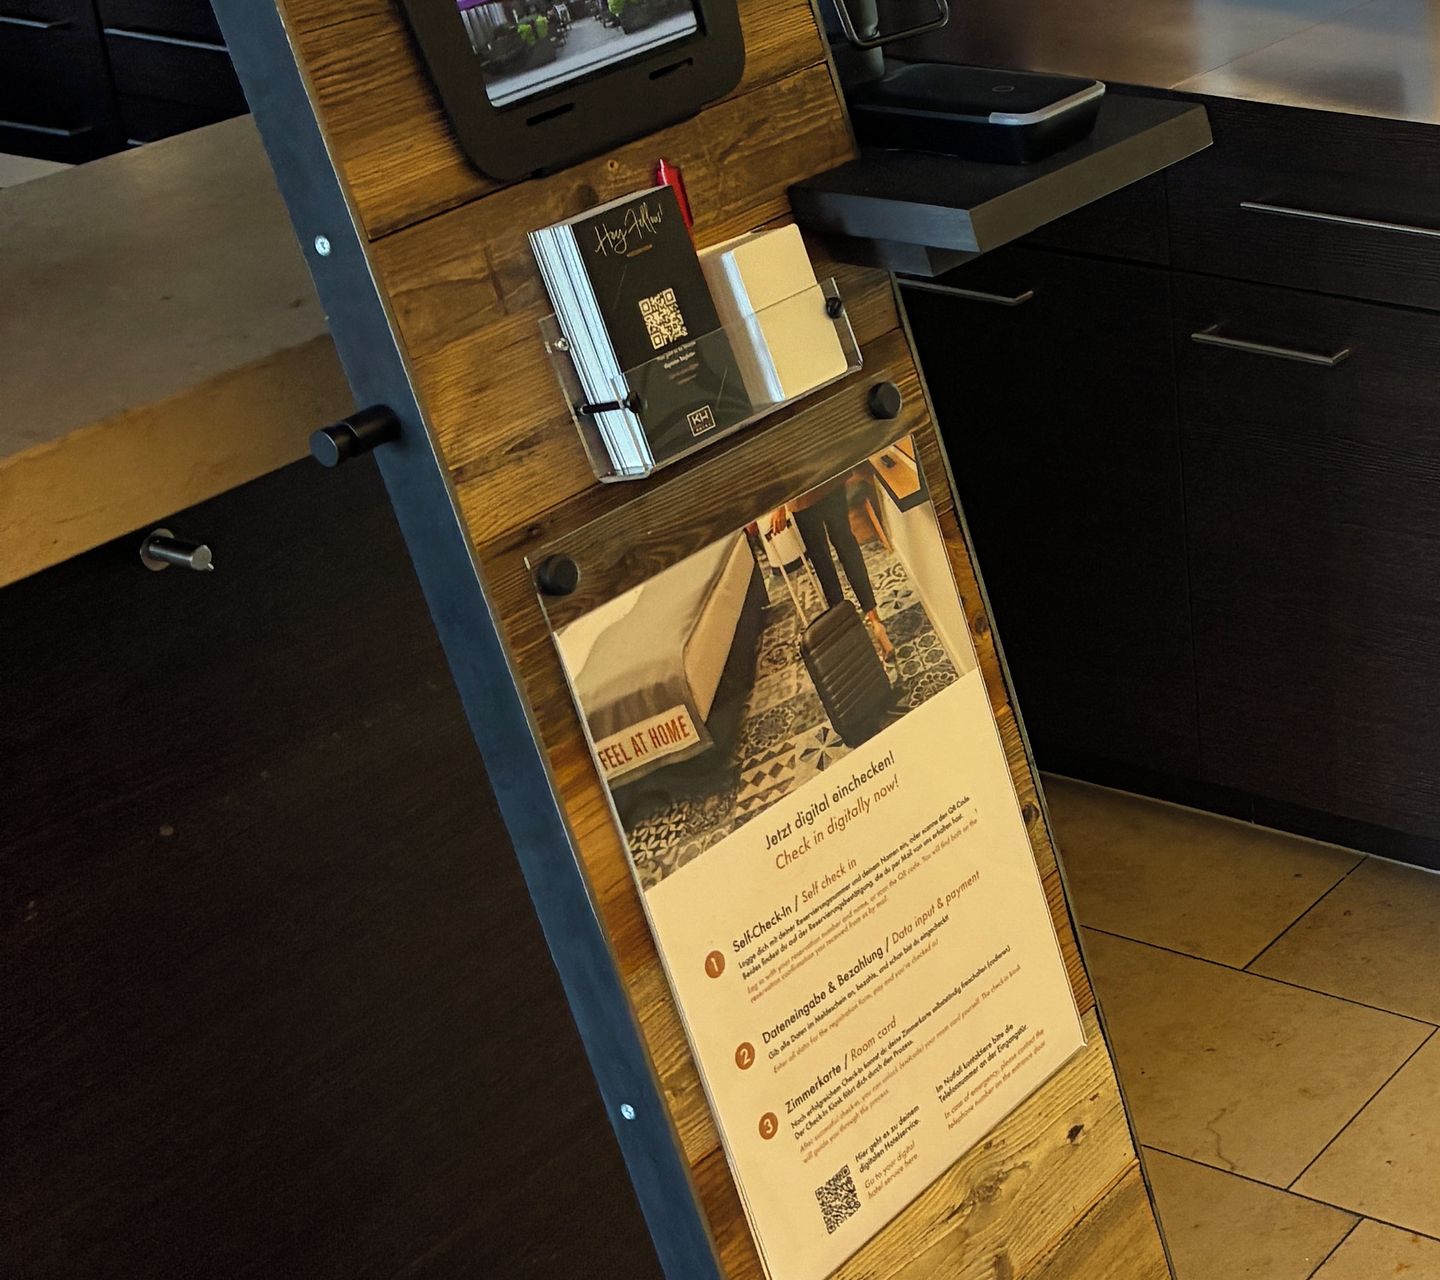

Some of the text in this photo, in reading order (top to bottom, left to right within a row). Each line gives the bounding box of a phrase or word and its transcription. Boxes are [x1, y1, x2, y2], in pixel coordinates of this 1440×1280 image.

[692, 408, 709, 427] KH
[598, 715, 690, 771] FEEL AT HOME
[765, 750, 894, 850] Jetzt digital einchecken!
[775, 773, 899, 869] Check in digitally now!
[710, 957, 718, 971] 1
[732, 905, 792, 952] Self-Check-In
[794, 894, 798, 912] /
[801, 880, 818, 903] Self
[820, 862, 846, 889] check
[847, 858, 857, 870] in
[739, 1047, 750, 1065] 2
[761, 991, 826, 1043] Dateneingabe
[827, 980, 836, 993] &
[836, 947, 883, 986] Bezahlung
[885, 935, 889, 953] /
[891, 923, 913, 944] Data
[914, 903, 935, 927] input
[936, 896, 944, 909] &
[945, 870, 979, 906] payment
[763, 1117, 773, 1134] 3
[784, 1064, 841, 1113] Zimmerkarte
[843, 1052, 848, 1070] /
[850, 1036, 875, 1061] Room
[876, 1014, 896, 1039] card
